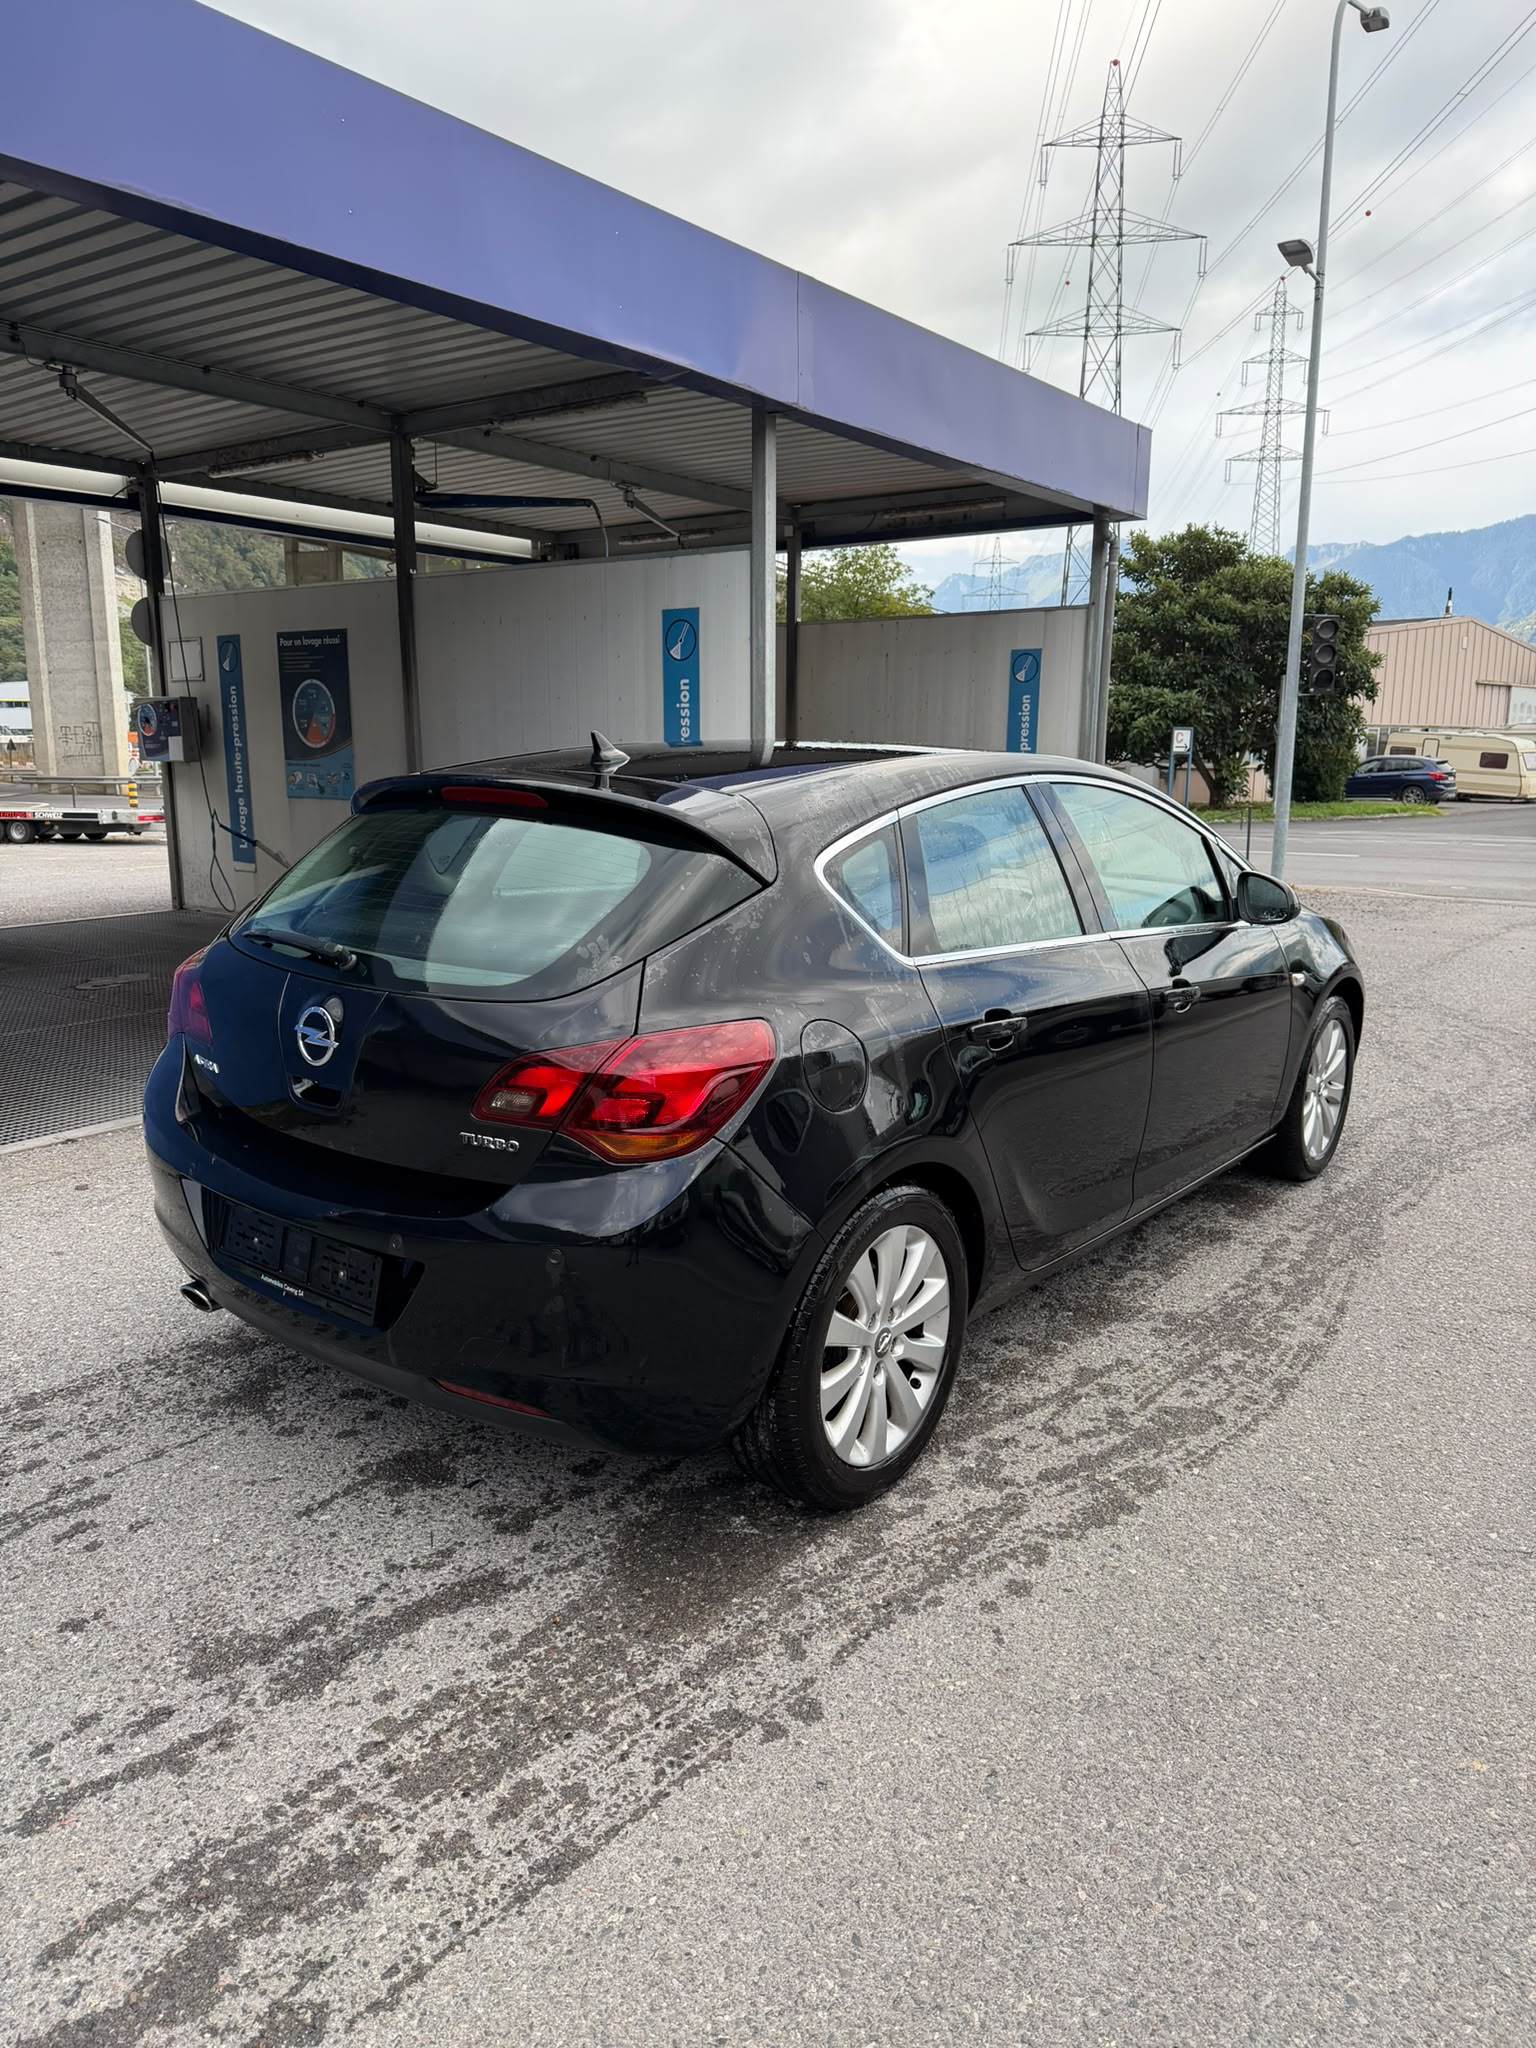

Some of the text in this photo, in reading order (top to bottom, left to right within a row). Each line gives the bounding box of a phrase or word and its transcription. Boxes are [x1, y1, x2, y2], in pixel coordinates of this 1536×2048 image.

[280, 634, 340, 648] Pour un lavage réussi
[228, 685, 244, 793] haute-pression
[1175, 731, 1184, 744] C
[459, 1131, 520, 1153] TURBO
